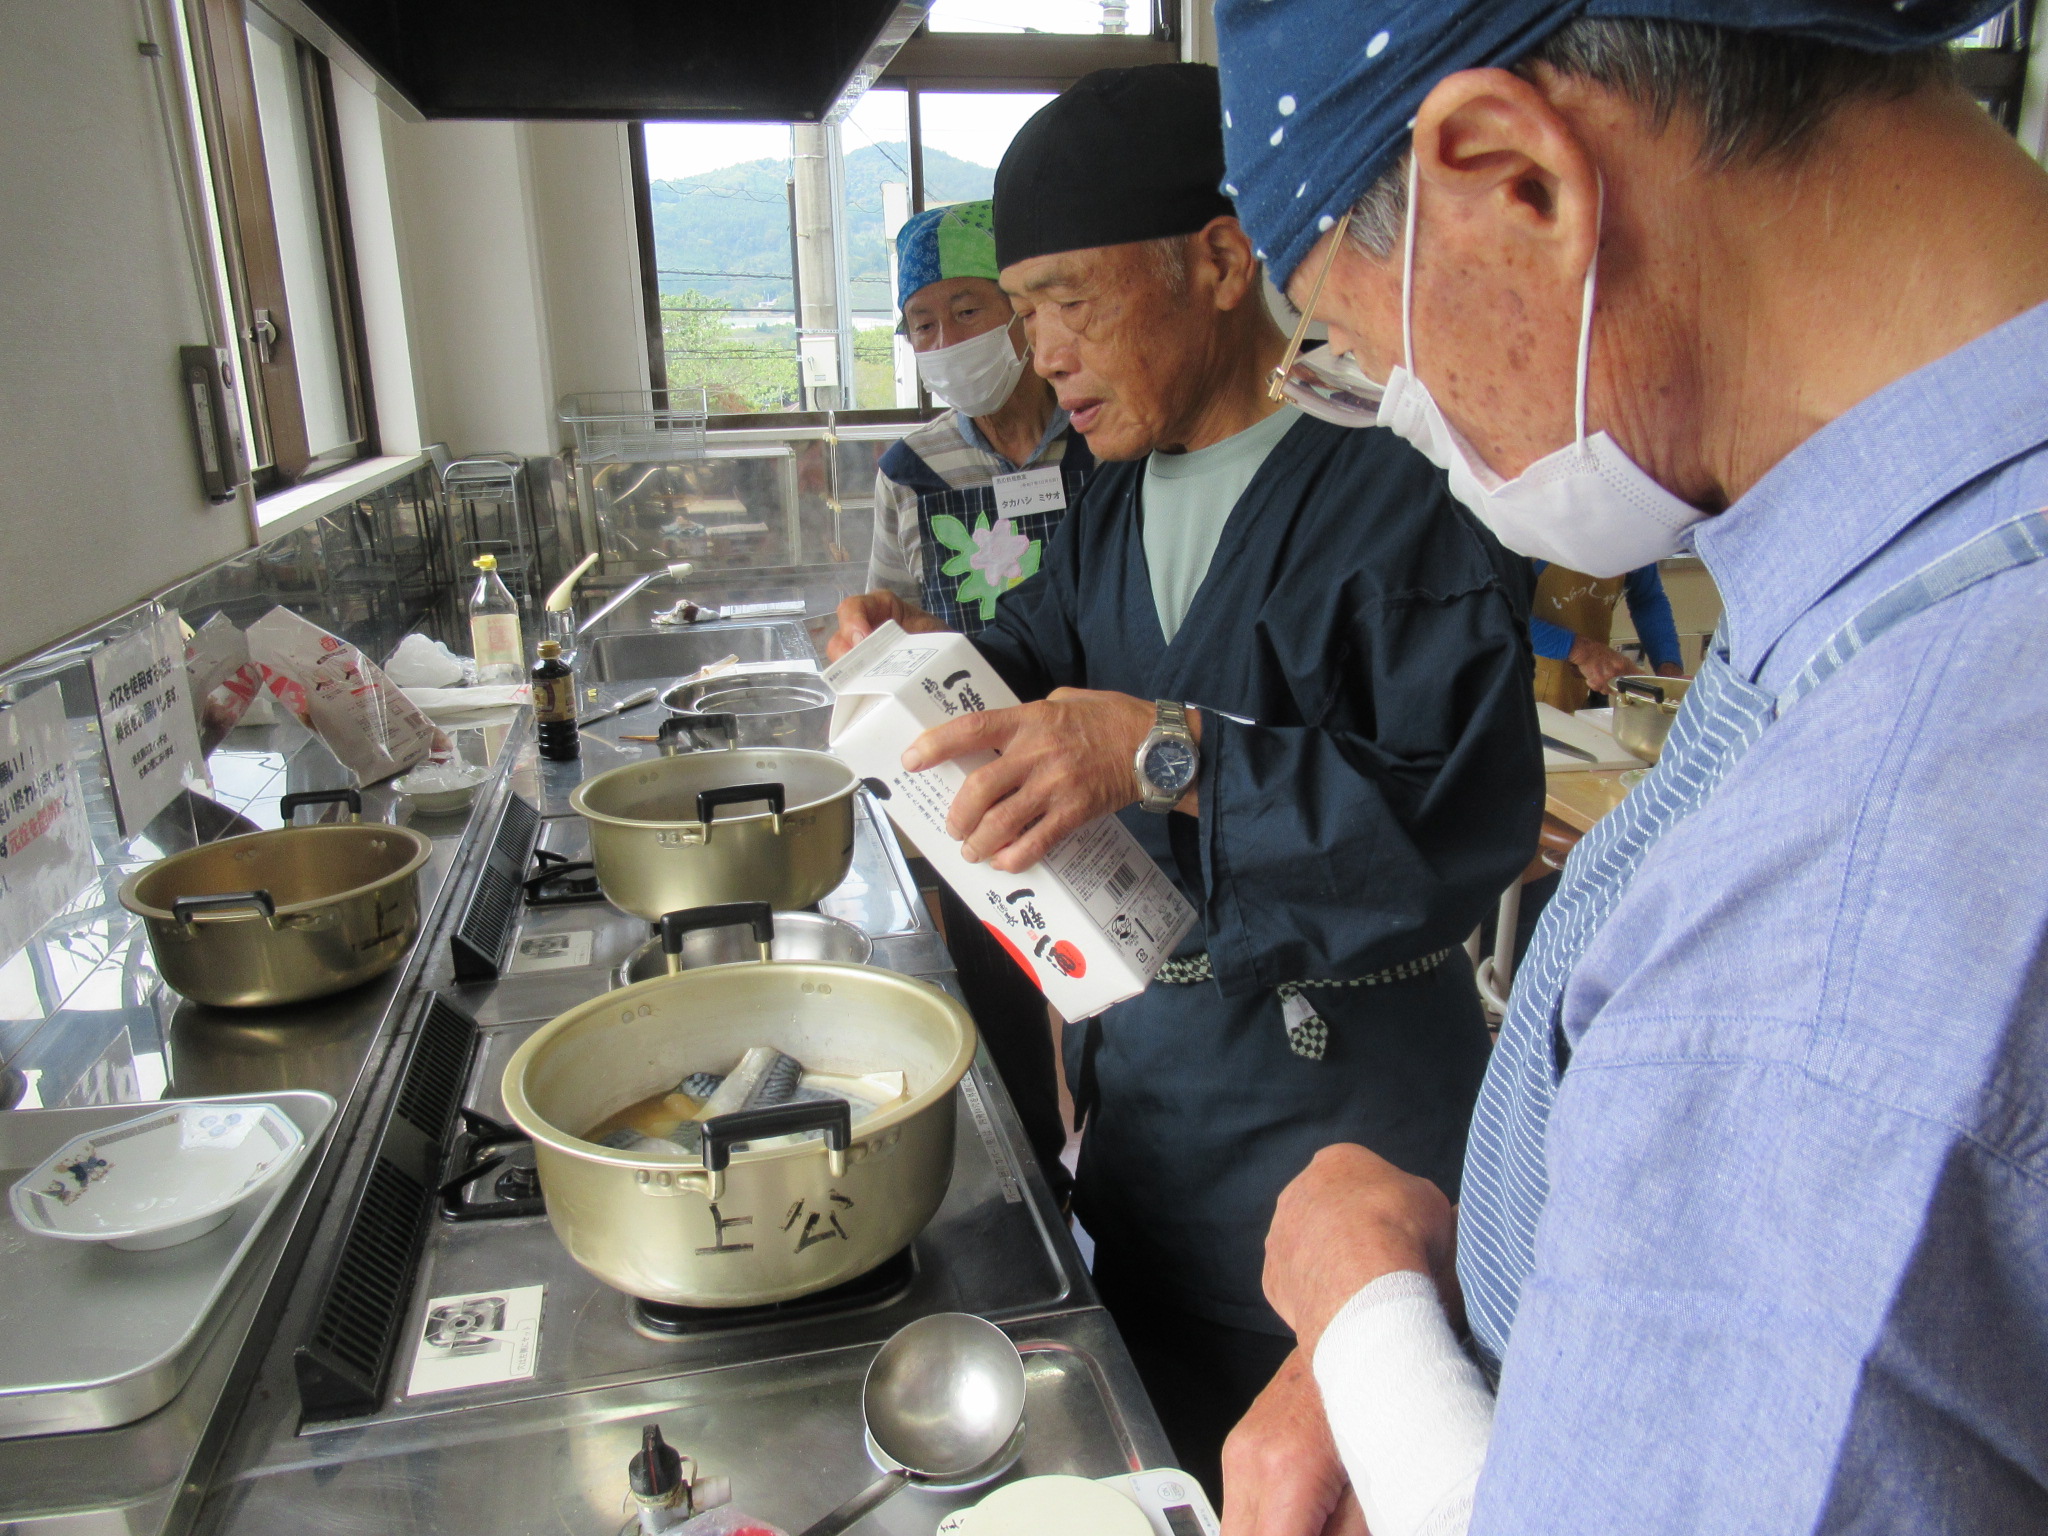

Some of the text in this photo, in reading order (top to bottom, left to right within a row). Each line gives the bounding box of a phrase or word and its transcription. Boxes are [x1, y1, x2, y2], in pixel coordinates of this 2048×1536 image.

[1001, 491, 1061, 509] タカハシ ミサオ
